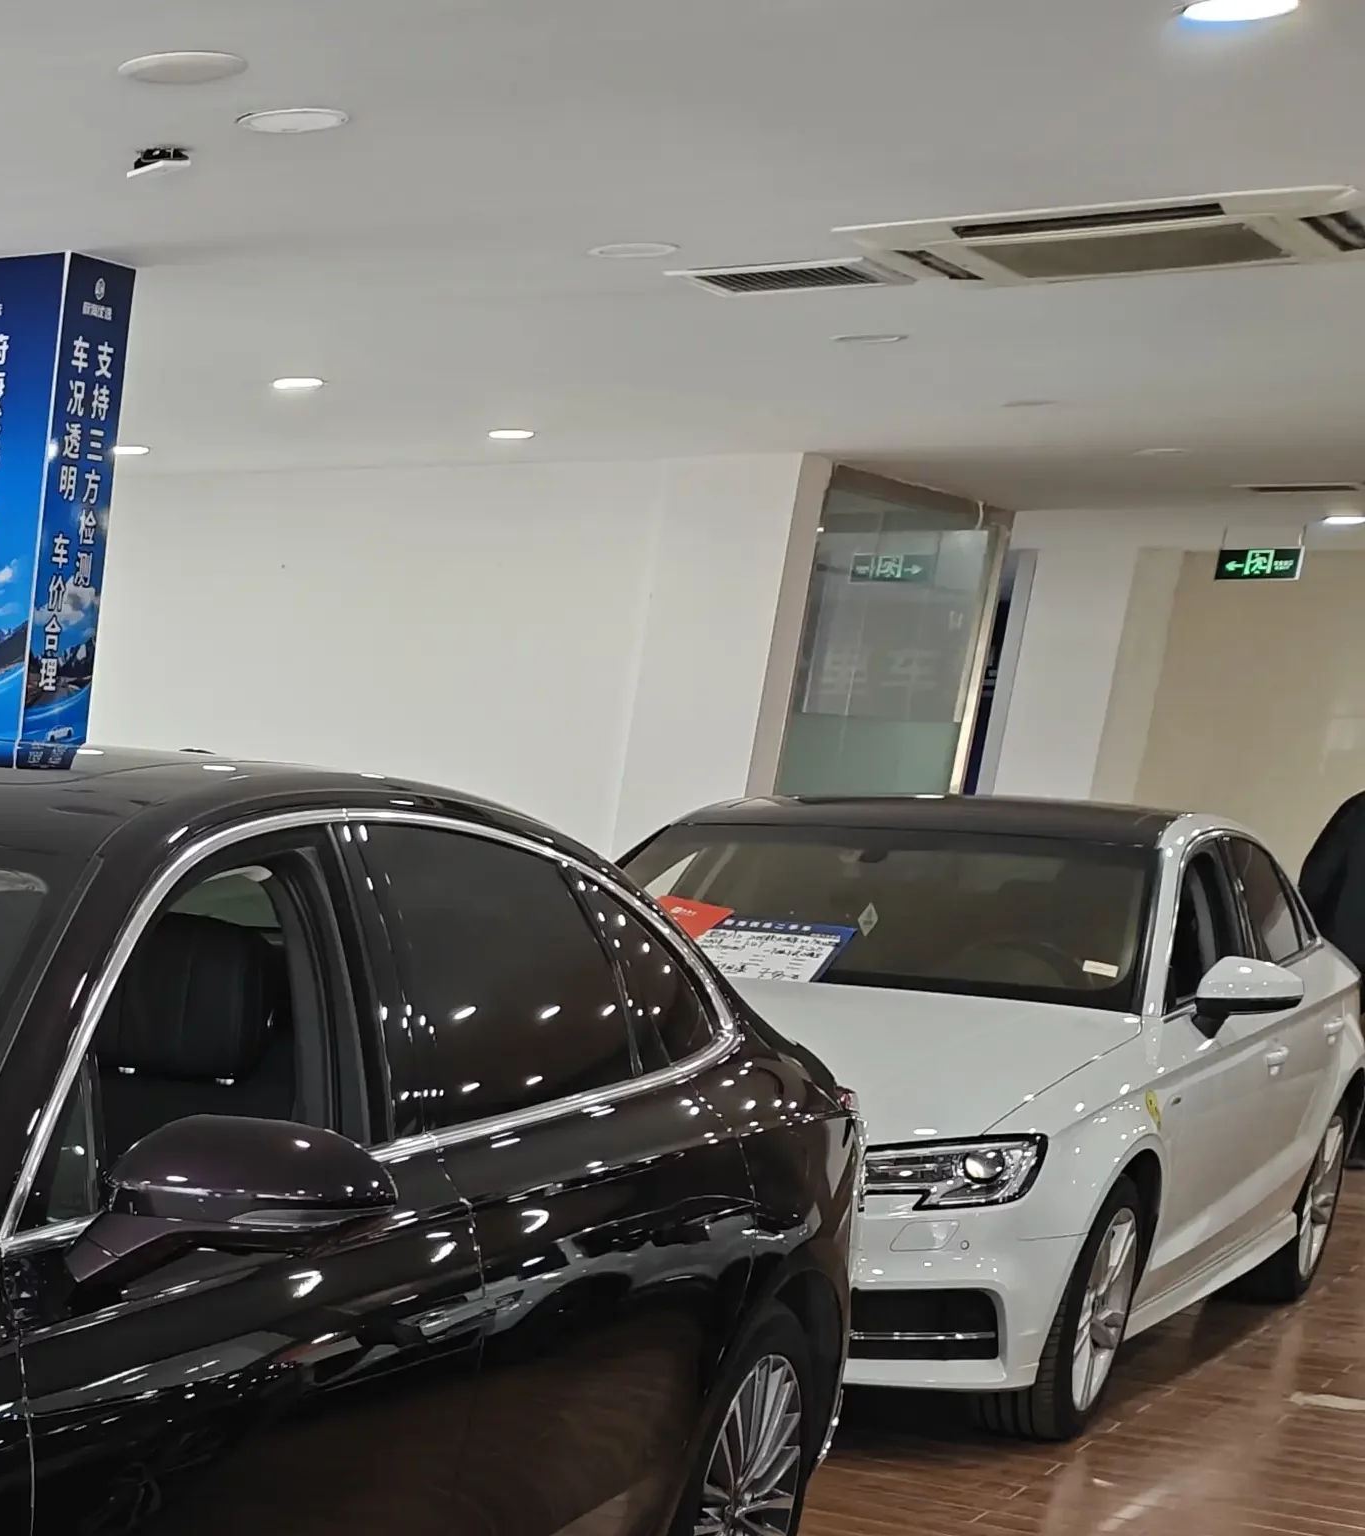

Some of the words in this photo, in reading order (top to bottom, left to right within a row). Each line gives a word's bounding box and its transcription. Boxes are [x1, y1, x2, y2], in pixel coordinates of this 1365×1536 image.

[58, 335, 90, 502] 车况透明
[74, 341, 114, 588] 支持三方检测
[39, 533, 70, 693] 车价合理
